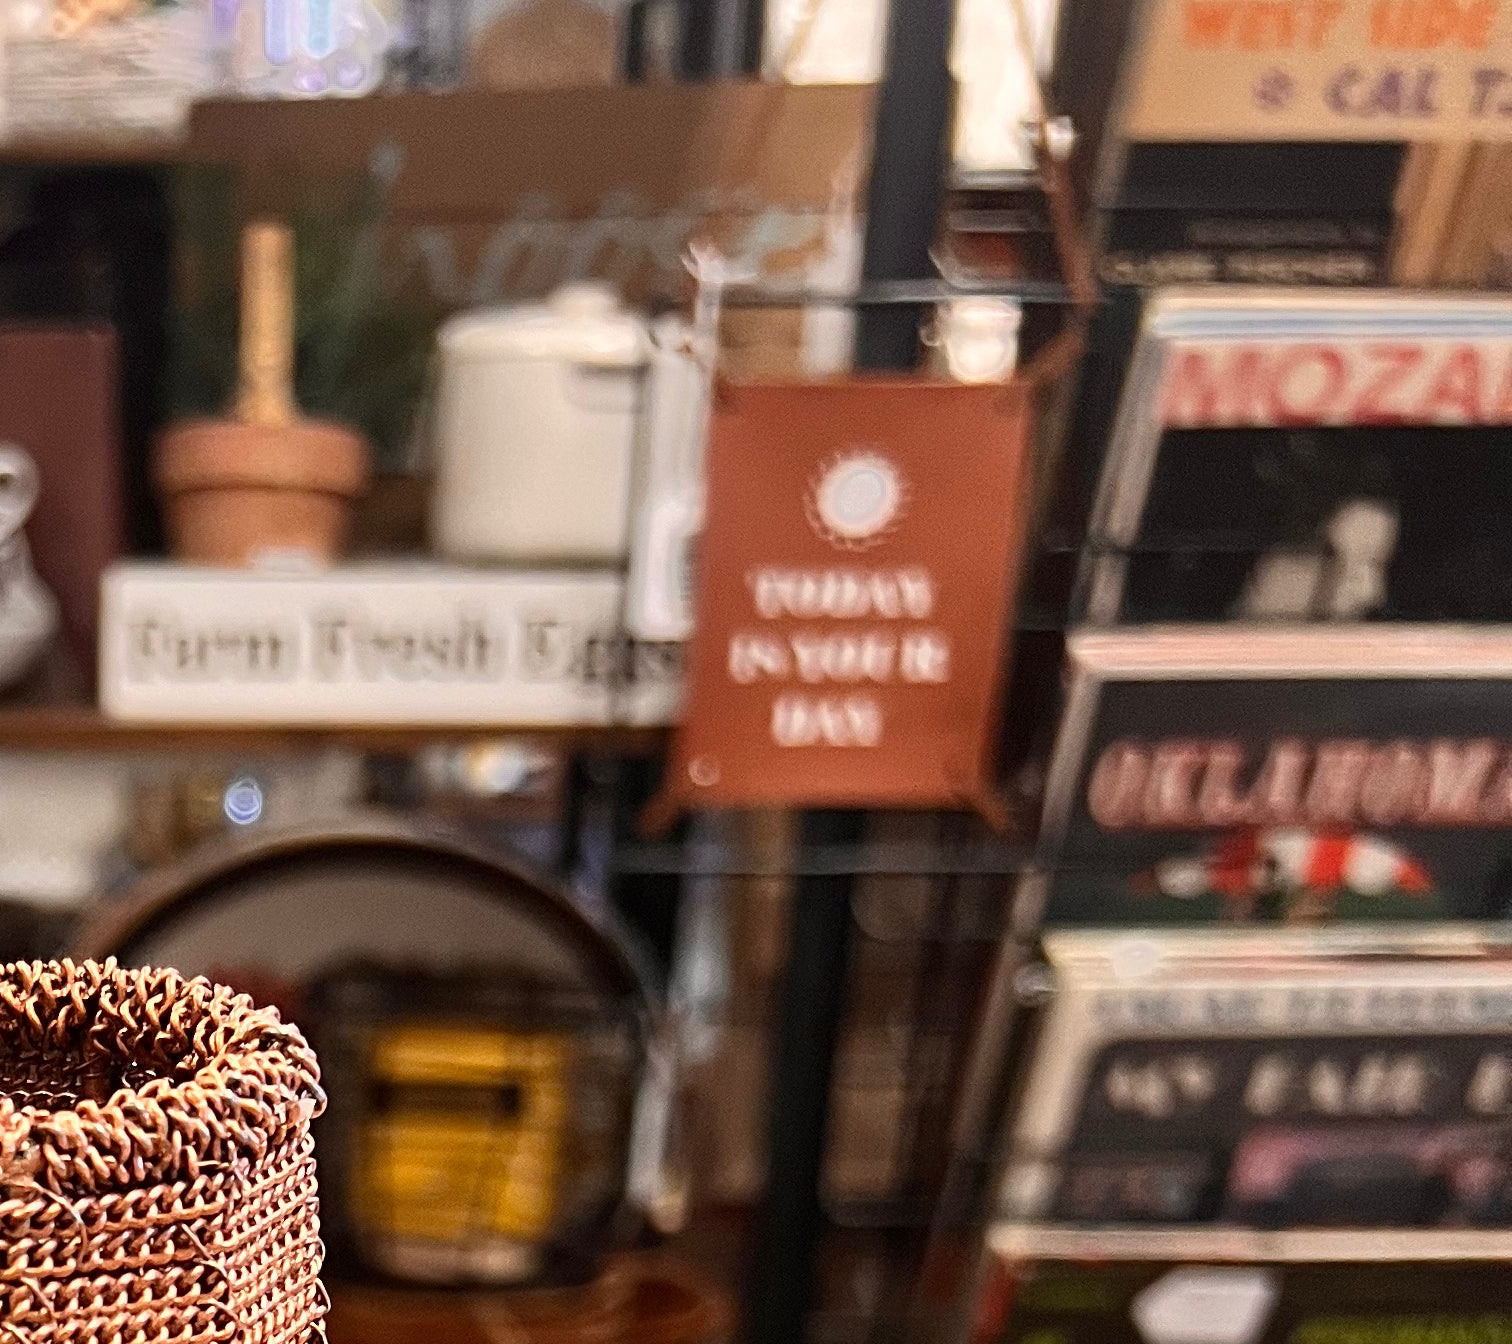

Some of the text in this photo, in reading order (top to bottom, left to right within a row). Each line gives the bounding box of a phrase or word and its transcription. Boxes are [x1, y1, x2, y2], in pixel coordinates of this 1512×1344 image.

[744, 567, 934, 620] TODAY
[124, 608, 290, 682] Farm
[308, 606, 500, 682] Fresh
[772, 698, 884, 748] DAY
